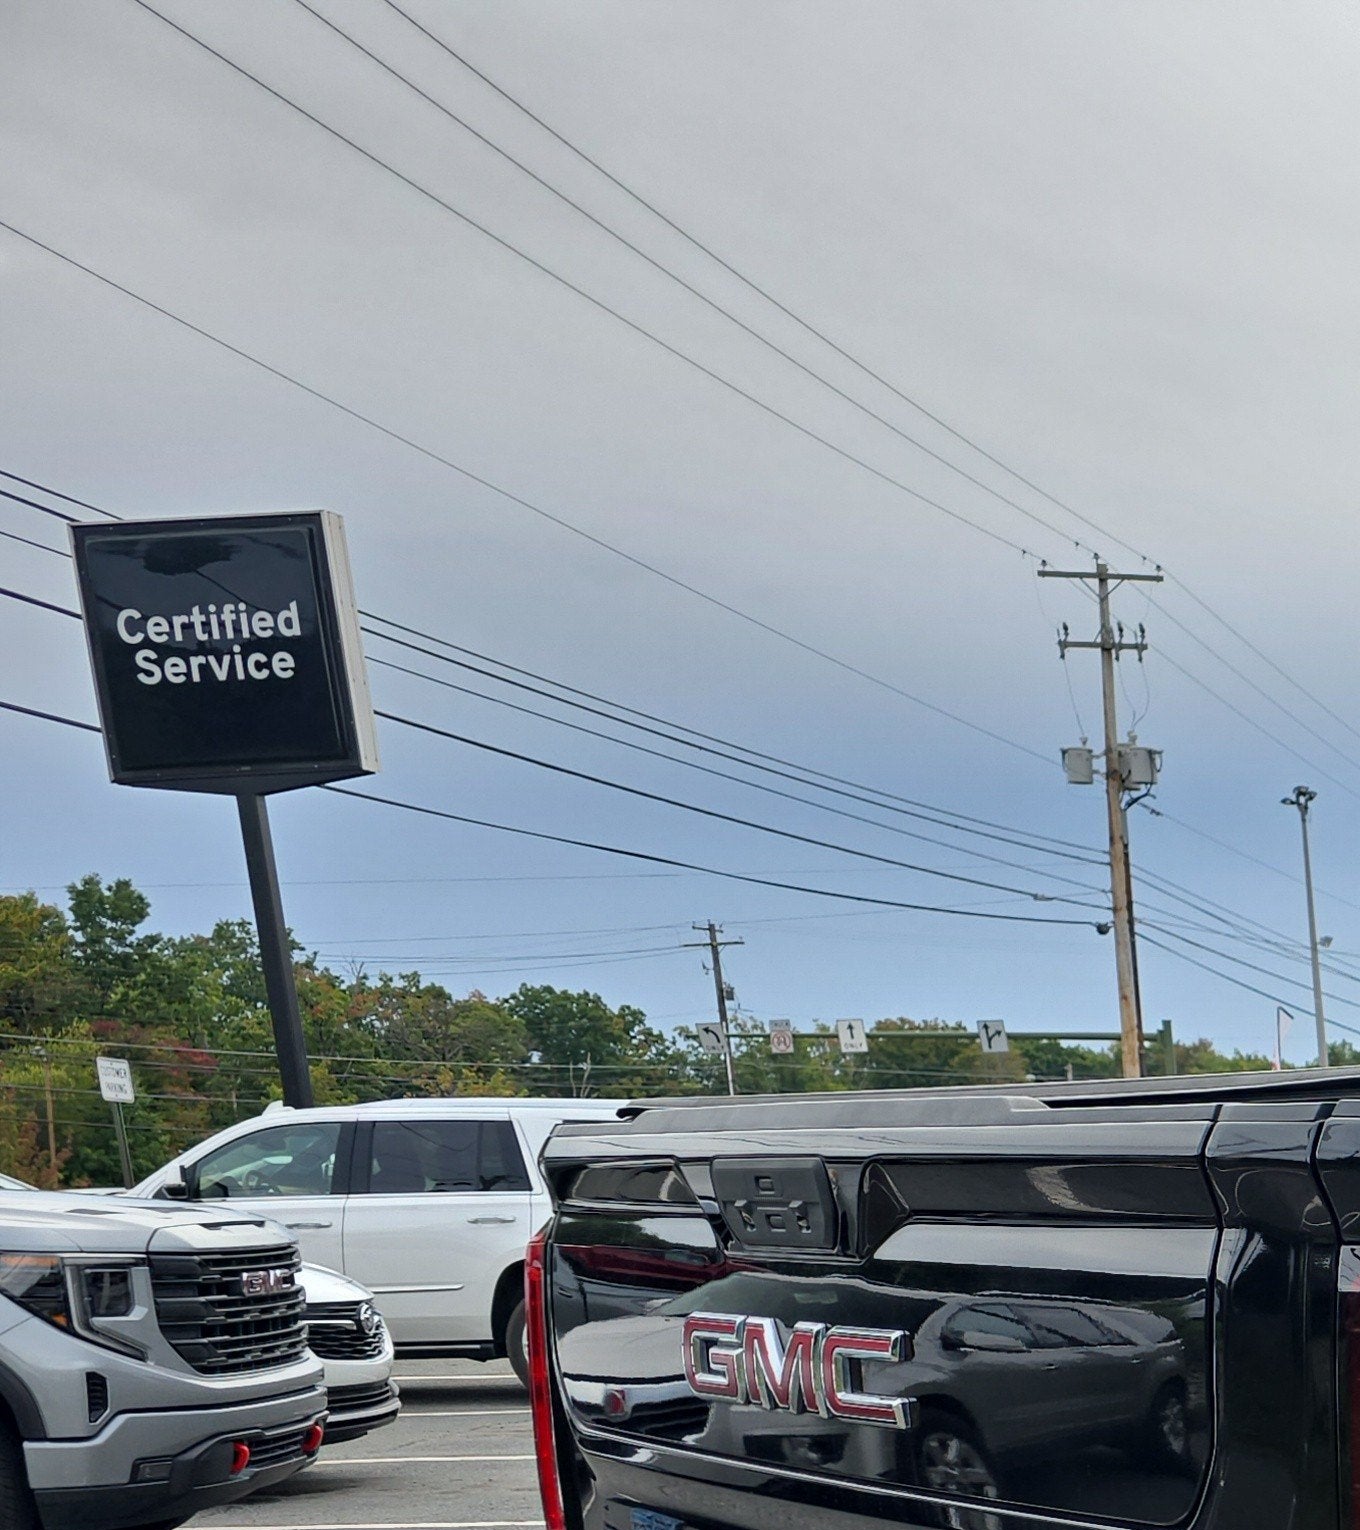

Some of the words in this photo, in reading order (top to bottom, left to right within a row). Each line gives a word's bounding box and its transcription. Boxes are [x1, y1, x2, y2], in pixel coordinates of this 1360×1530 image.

[117, 600, 302, 645] Certified
[135, 644, 296, 685] Service
[681, 1311, 916, 1430] GMC
